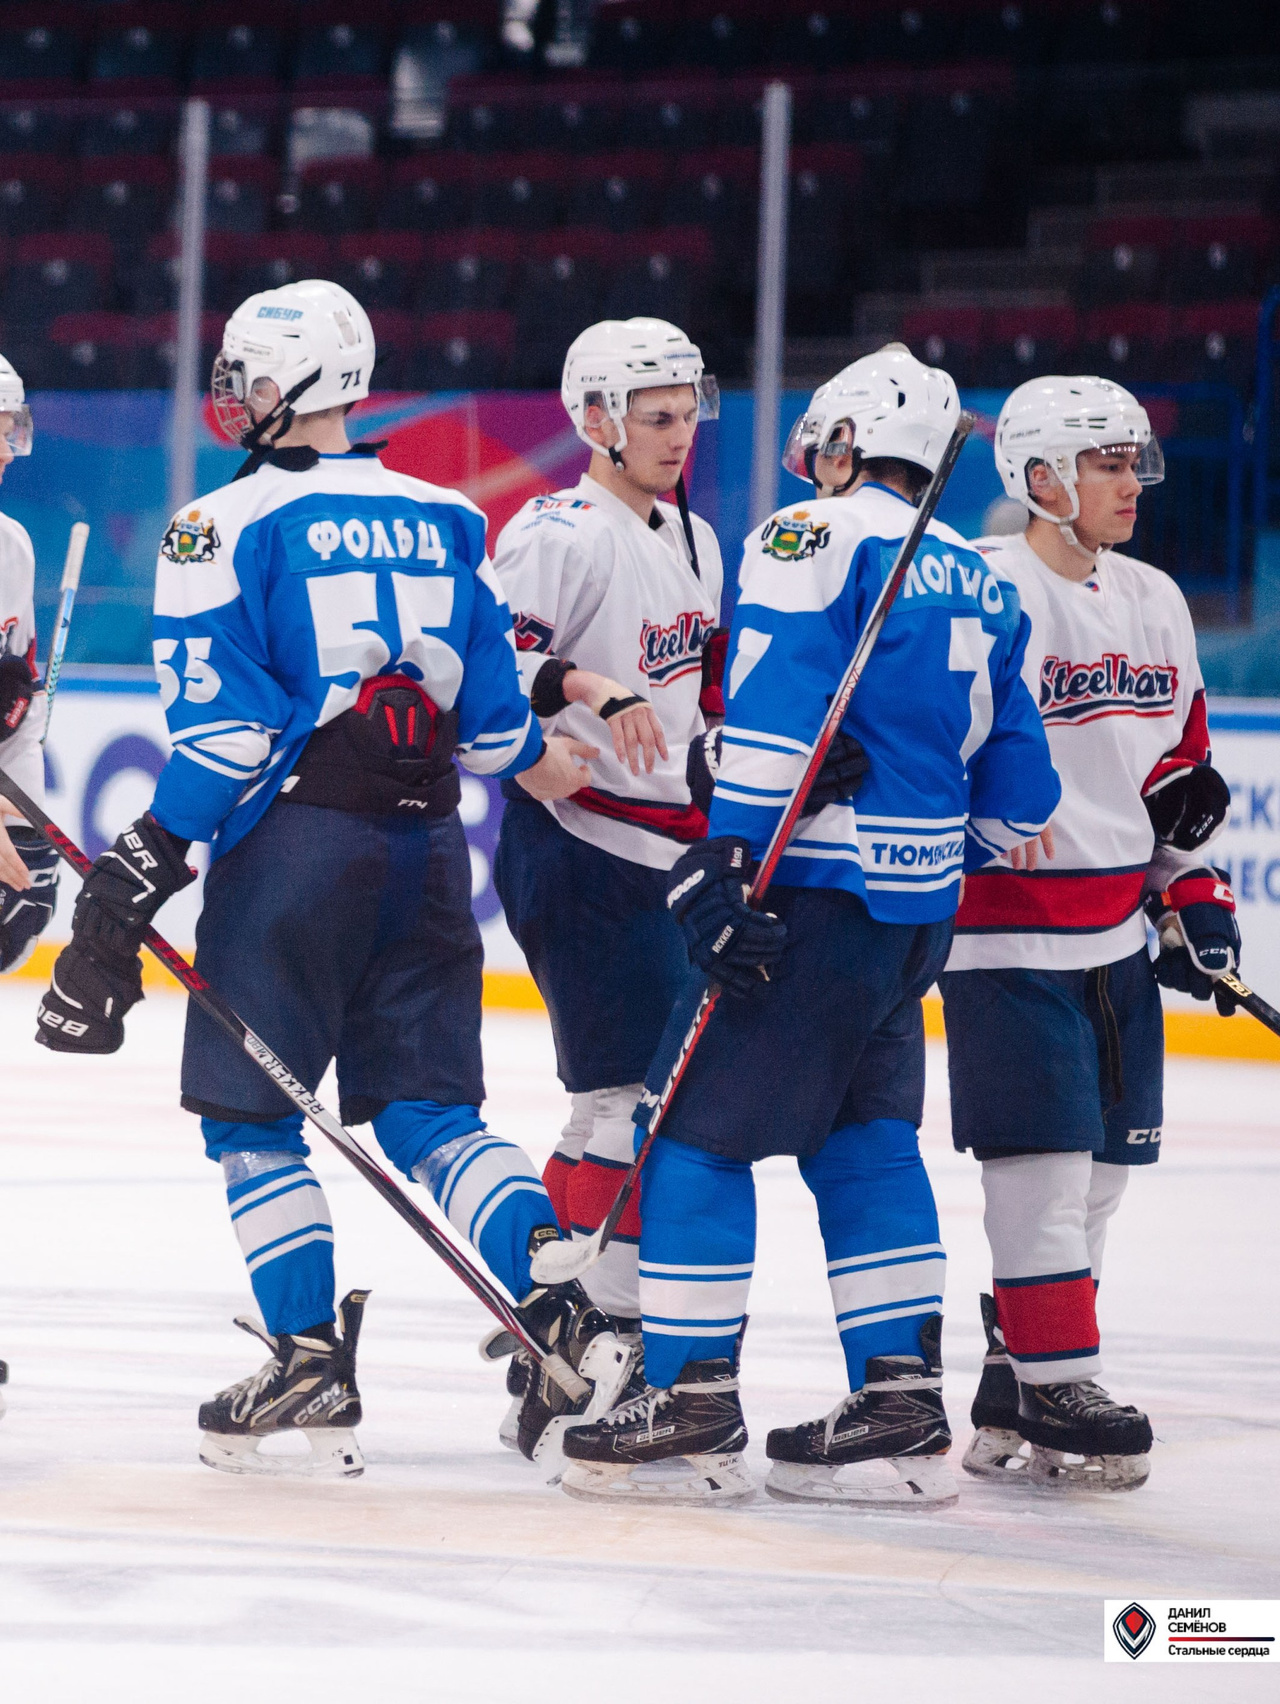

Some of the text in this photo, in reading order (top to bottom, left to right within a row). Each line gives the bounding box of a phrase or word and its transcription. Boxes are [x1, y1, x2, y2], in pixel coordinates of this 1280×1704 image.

[257, 306, 304, 322] СИБУР
[340, 368, 363, 391] 71
[581, 375, 607, 383] CCM
[307, 517, 447, 568] ФОЛЬЦ
[305, 571, 465, 729] 55
[1195, 814, 1215, 839] CCM
[730, 846, 743, 869] M90
[711, 924, 735, 954] REKKER
[1198, 948, 1229, 957] CCM
[263, 1052, 326, 1114] REKKER
[293, 1382, 342, 1426] CCM
[833, 1426, 869, 1443] BAUER
